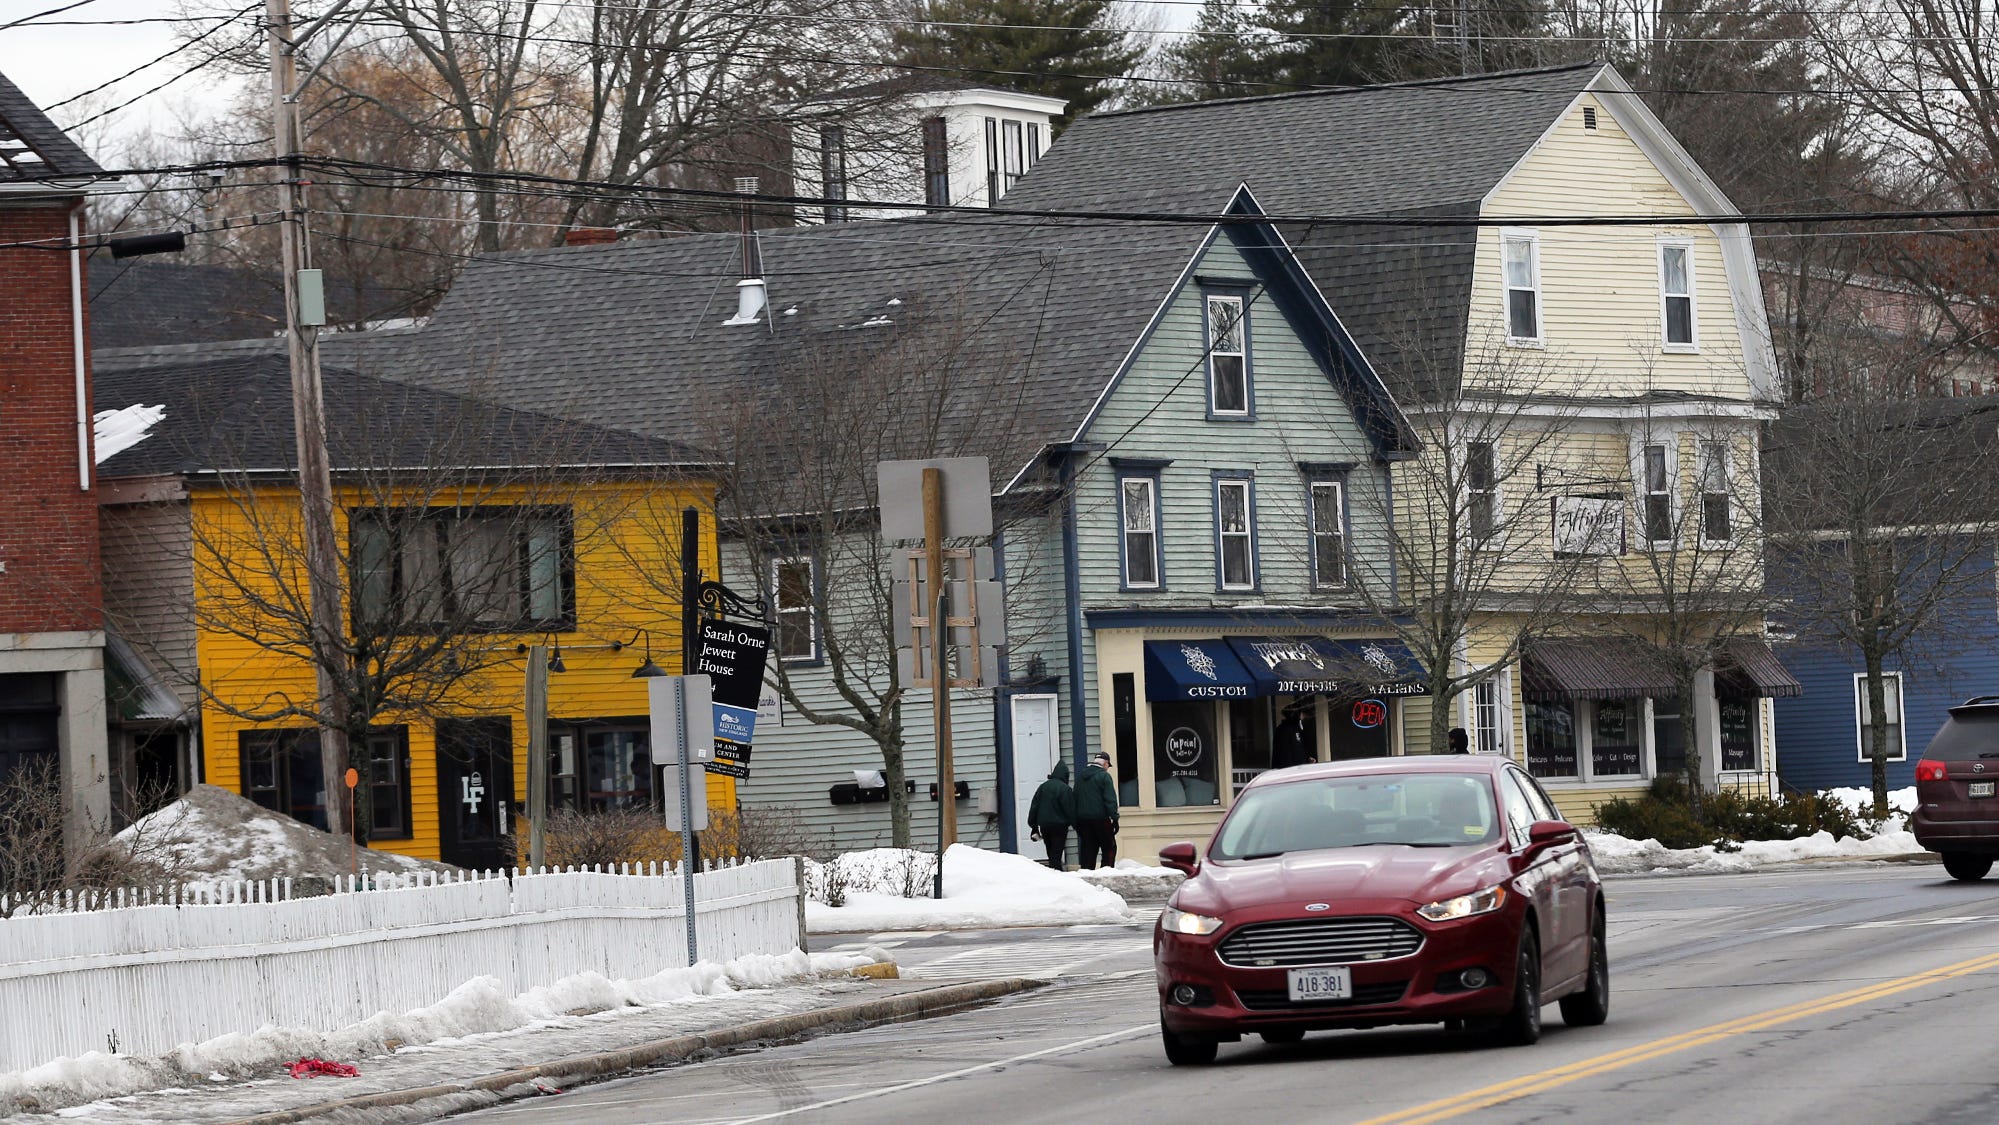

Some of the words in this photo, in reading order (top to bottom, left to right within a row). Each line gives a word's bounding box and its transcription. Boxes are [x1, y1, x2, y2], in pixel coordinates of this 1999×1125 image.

[704, 625, 735, 643] Sarah
[737, 632, 765, 649] Orne
[700, 642, 736, 659] Jewett
[699, 658, 734, 676] House
[1187, 686, 1248, 697] CUSTOM
[1353, 701, 1384, 725] OPEN
[719, 721, 749, 732] HISTORIC
[723, 744, 738, 752] AND
[716, 749, 740, 760] CENTER
[1609, 753, 1617, 761] Cut
